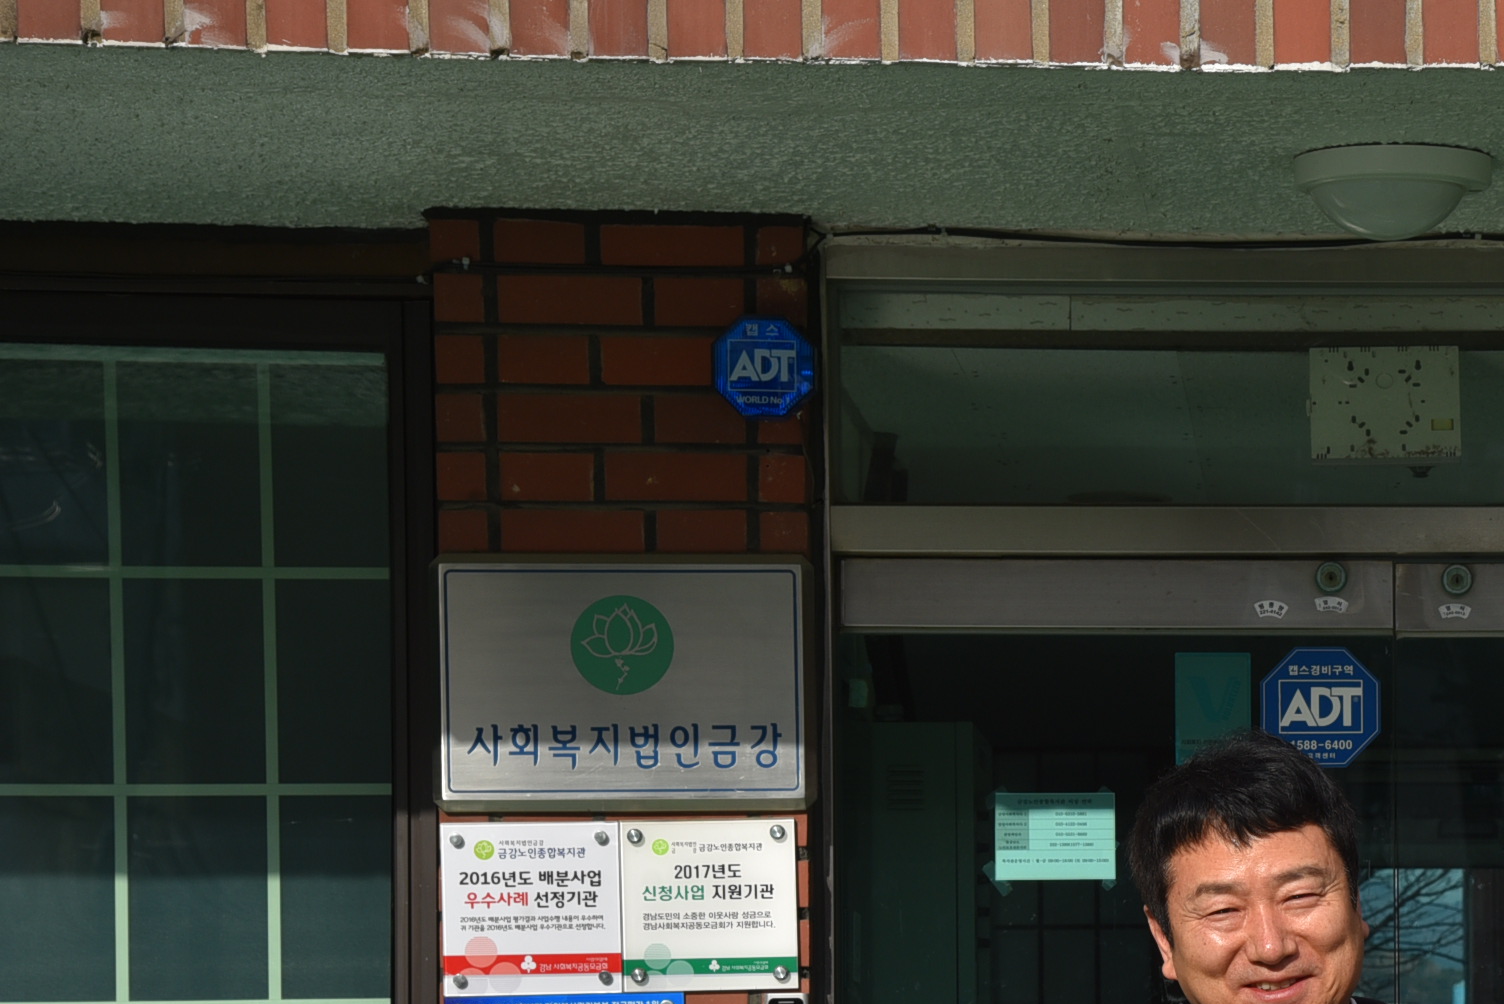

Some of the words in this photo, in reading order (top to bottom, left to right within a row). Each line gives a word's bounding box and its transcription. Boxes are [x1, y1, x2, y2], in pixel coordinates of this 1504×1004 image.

[729, 348, 797, 382] ADT
[736, 396, 768, 405] WORLD
[1288, 665, 1354, 676] 캡스경비구역
[1280, 687, 1363, 727] ADT
[467, 722, 783, 770] 사회복지법인금강
[498, 847, 586, 859] 금강노인종합복지관
[699, 843, 763, 851] 금강노인종합복지관
[459, 871, 534, 887] 2016년도
[538, 870, 602, 888] 배분사업
[674, 863, 742, 879] 2017년도
[464, 892, 529, 909] 우수사례
[534, 891, 598, 908] 선정기관
[642, 885, 705, 901] 신청사업
[712, 884, 775, 900] 지원기관
[642, 912, 680, 921] 경남도민의
[683, 911, 706, 920] 소중한
[708, 911, 739, 920] 이웃사랑
[742, 910, 771, 919] 성금으로
